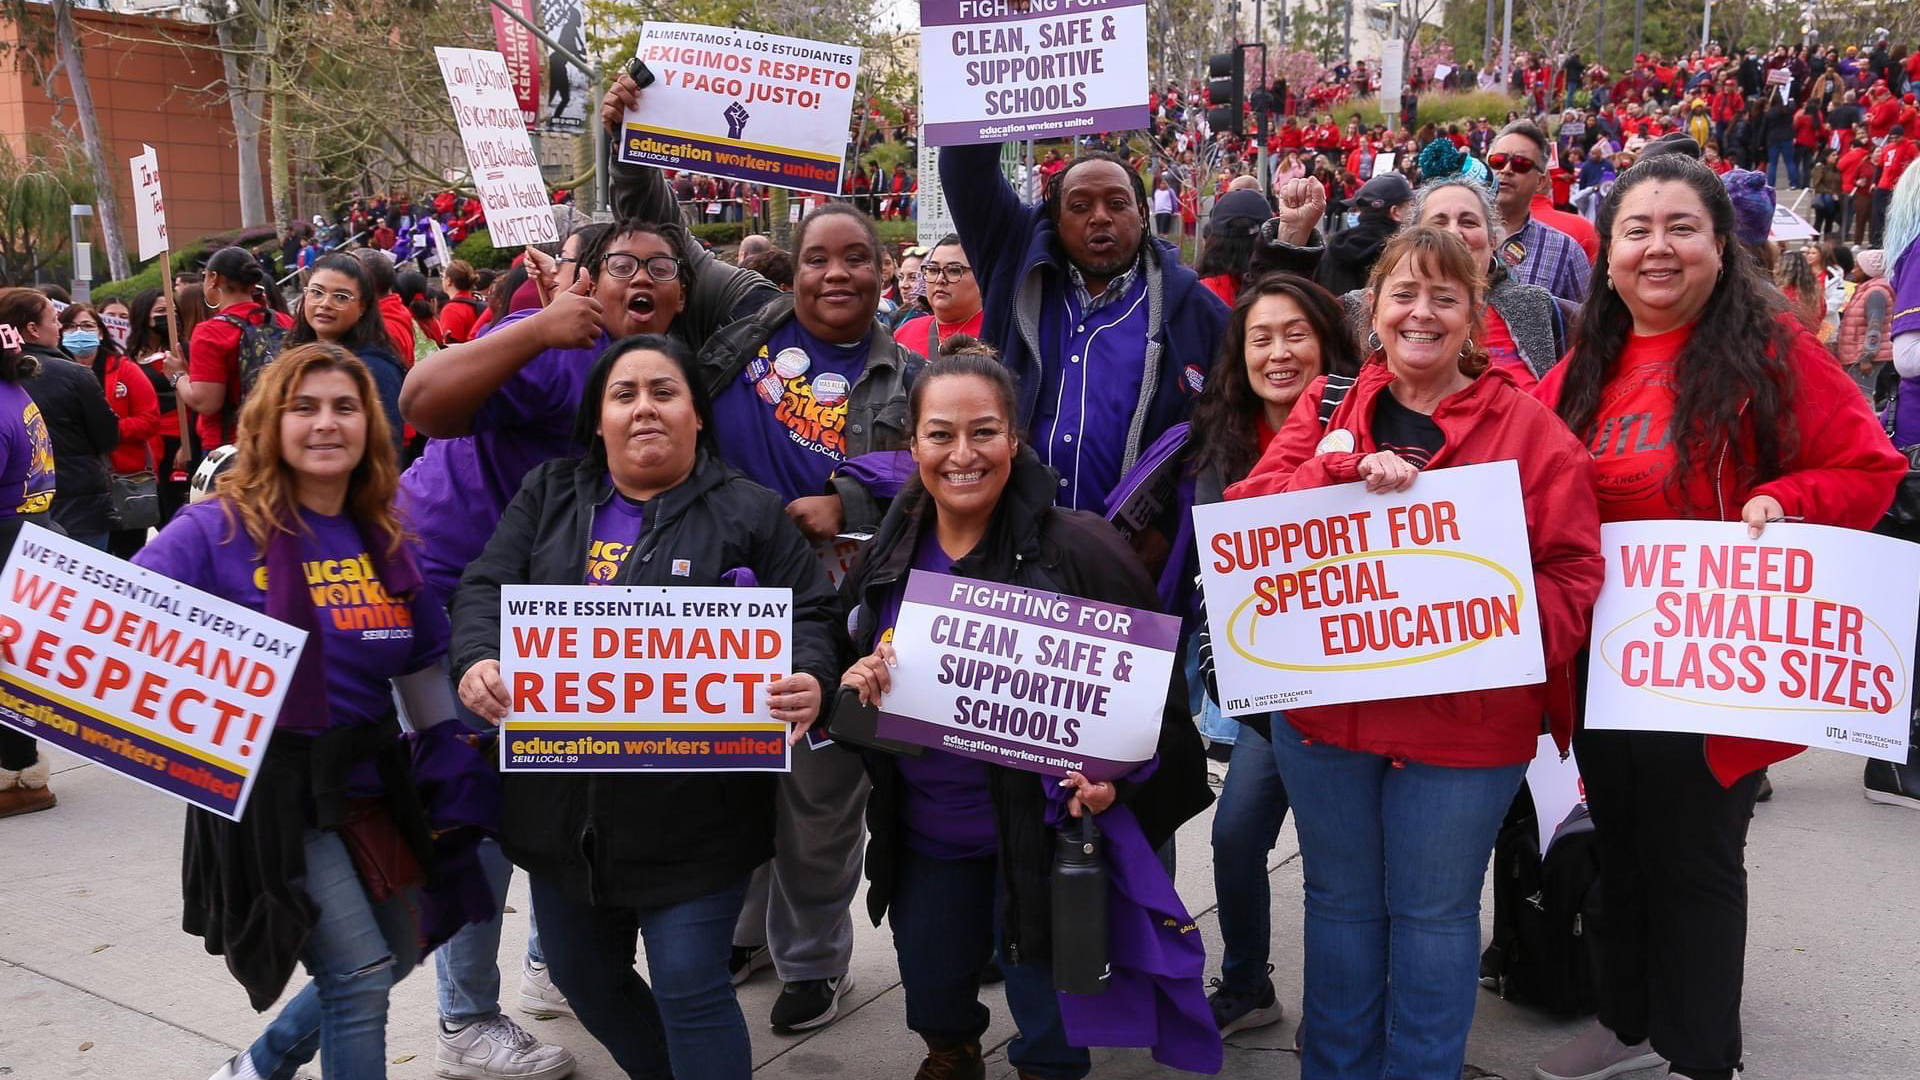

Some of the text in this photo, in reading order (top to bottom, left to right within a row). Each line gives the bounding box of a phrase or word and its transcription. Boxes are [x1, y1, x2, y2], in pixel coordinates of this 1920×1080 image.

[646, 30, 853, 66] ALIMENTAMOS A LOS ESTUDIANTES
[952, 15, 1116, 56] CLEAN, SAFE &
[642, 46, 851, 89] ¡EXIGIMOS RESPETO
[966, 48, 1104, 86] SUPPORTIVE
[663, 69, 821, 110] Y PAGO JUSTO!
[985, 81, 1087, 115] SCHOOLS
[980, 117, 1094, 135] education workers united
[628, 150, 680, 164] SEIU LOCAL 99
[629, 137, 836, 181] education workers united
[809, 442, 840, 461] LOCAL
[1211, 500, 1461, 574] SUPPORT FOR
[1254, 560, 1400, 617] SPECIAL
[1620, 544, 1814, 594] WE NEED
[22, 540, 297, 659] WE'RE ESSENTIAL EVERY DAY
[508, 600, 788, 618] WE'RE ESSENTIAL EVERY DAY
[950, 583, 1133, 636] FIGHTING FOR
[11, 568, 276, 698] WE DEMAND
[512, 626, 782, 660] WE DEMAND
[1319, 594, 1521, 657] EDUCATION
[1654, 591, 1864, 656] SMALLER
[930, 615, 1134, 683] CLEAN, SAFE &
[0, 613, 264, 757] RESPECT!
[937, 653, 1111, 718] SUPPORTIVE
[1255, 689, 1313, 701] UNITED TEACHERS
[1621, 640, 1895, 715] CLASS SIZES
[1227, 698, 1251, 711] UTLA
[1269, 697, 1298, 705] ANGELES
[953, 695, 1081, 749] SCHOOLS
[1826, 726, 1848, 741] UTLA
[1852, 731, 1902, 746] UNITED TEACHERS
[80, 724, 168, 772] workers
[168, 761, 242, 801] united
[511, 737, 782, 756] education workers united
[511, 755, 578, 764] SEIU LOCAL 99
[943, 734, 1083, 771] education workers united
[1864, 739, 1889, 749] ANGELES
